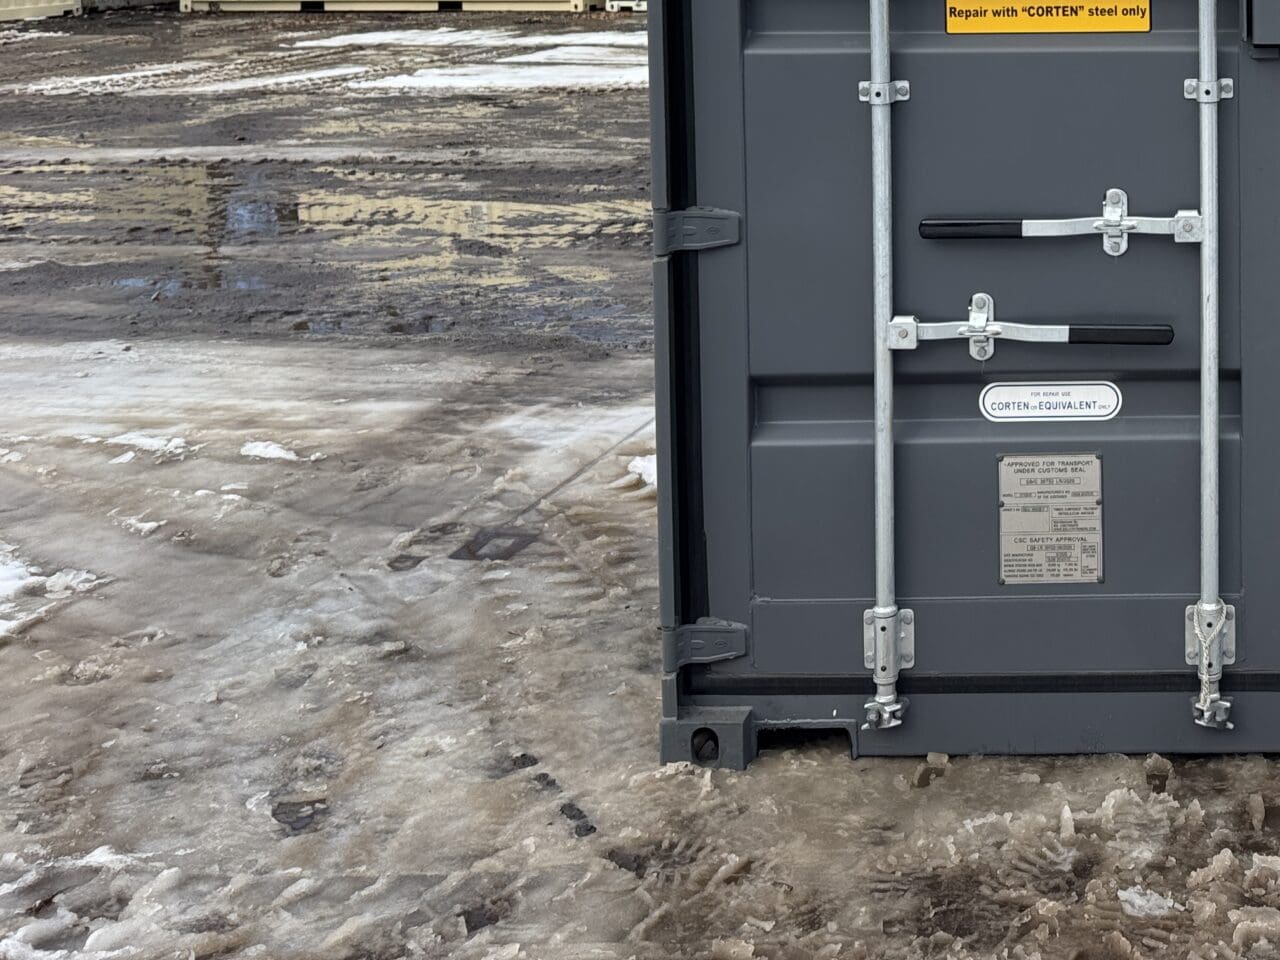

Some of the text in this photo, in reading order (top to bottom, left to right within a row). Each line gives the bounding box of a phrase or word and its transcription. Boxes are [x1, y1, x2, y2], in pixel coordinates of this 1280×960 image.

[949, 6, 988, 20] Repair
[992, 6, 1018, 18] with
[1088, 5, 1118, 17] steel
[1122, 5, 1147, 19] only
[990, 401, 1029, 411] CORTEN
[1038, 400, 1098, 410] EQUIVALENT
